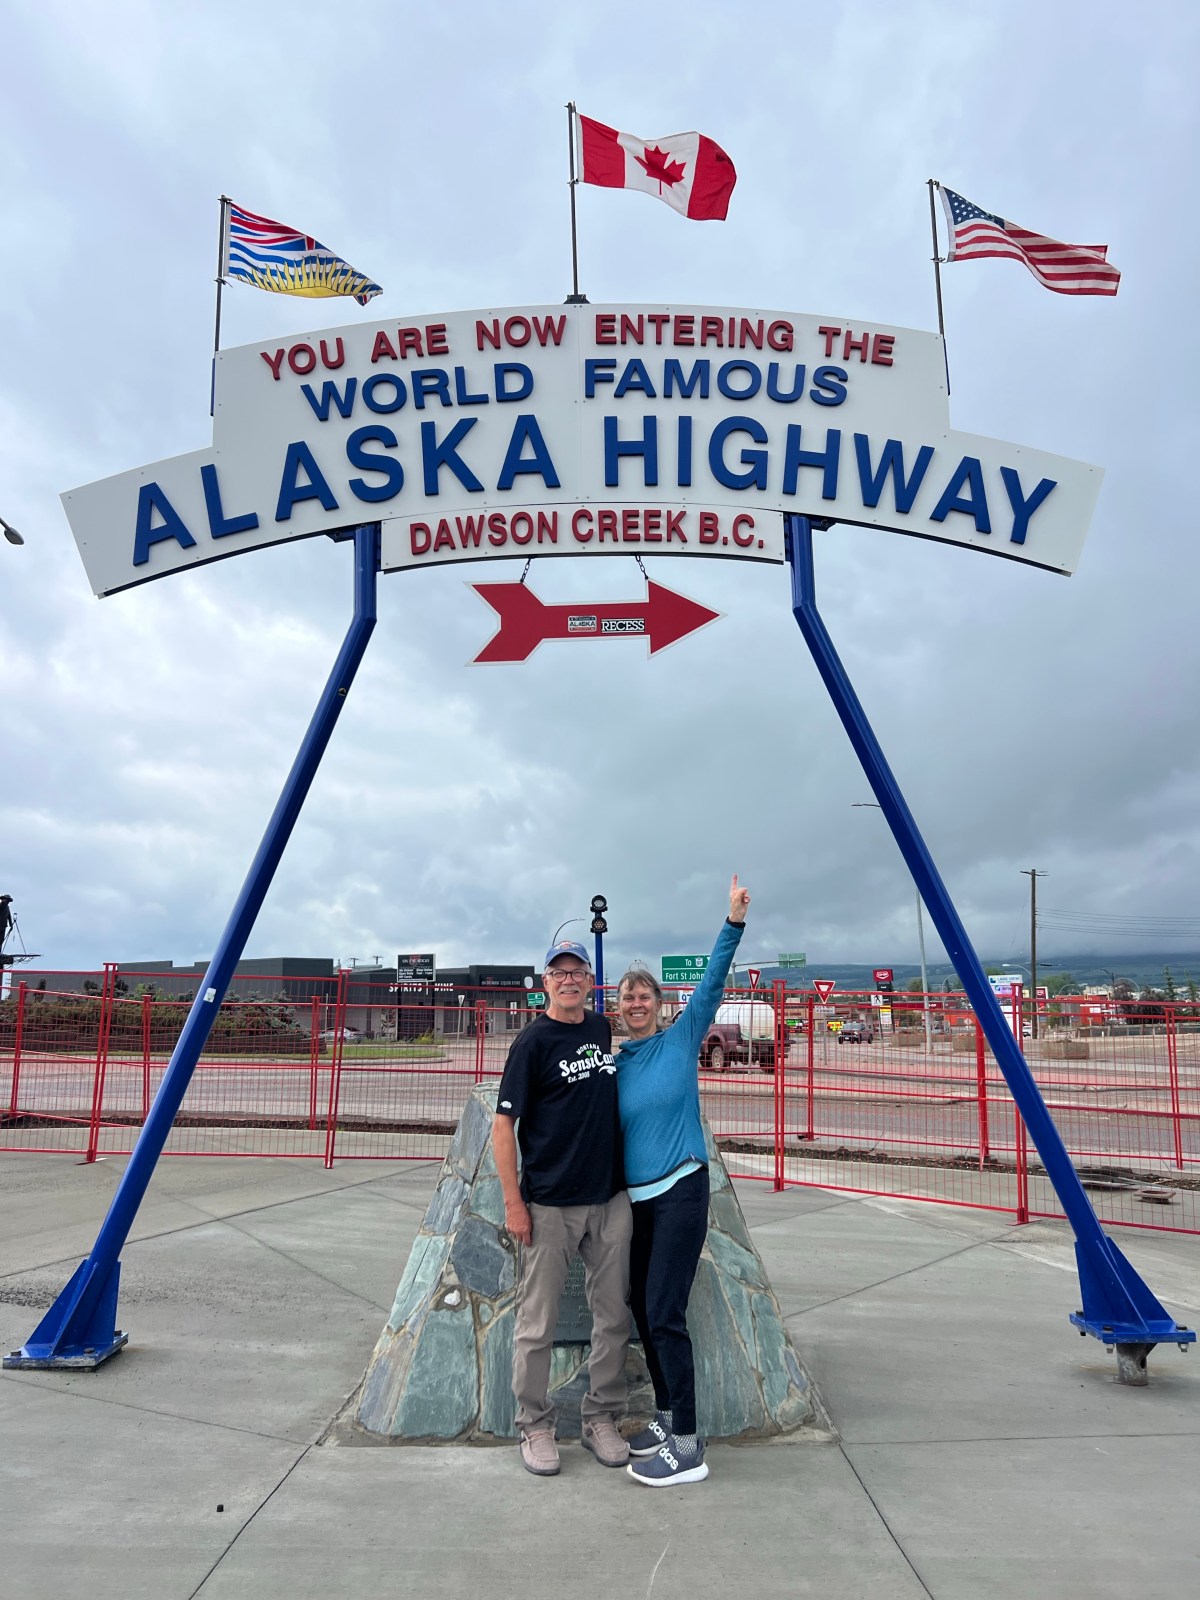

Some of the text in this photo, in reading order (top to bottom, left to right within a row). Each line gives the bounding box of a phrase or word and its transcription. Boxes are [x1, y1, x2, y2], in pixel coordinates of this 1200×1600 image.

[260, 314, 896, 381] YOU ARE NOW ENTERING THE
[300, 358, 849, 421] WORLD FAMOUS
[133, 415, 1058, 566] ALASKA HIGHWAY
[410, 509, 765, 555] DAWSON CREEK B.C.
[601, 620, 645, 631] RECESS
[685, 958, 692, 967] To
[665, 972, 679, 980] Fort
[681, 972, 687, 980] St
[389, 983, 454, 993] SPIRITS WINE
[576, 1043, 600, 1056] MONTANA
